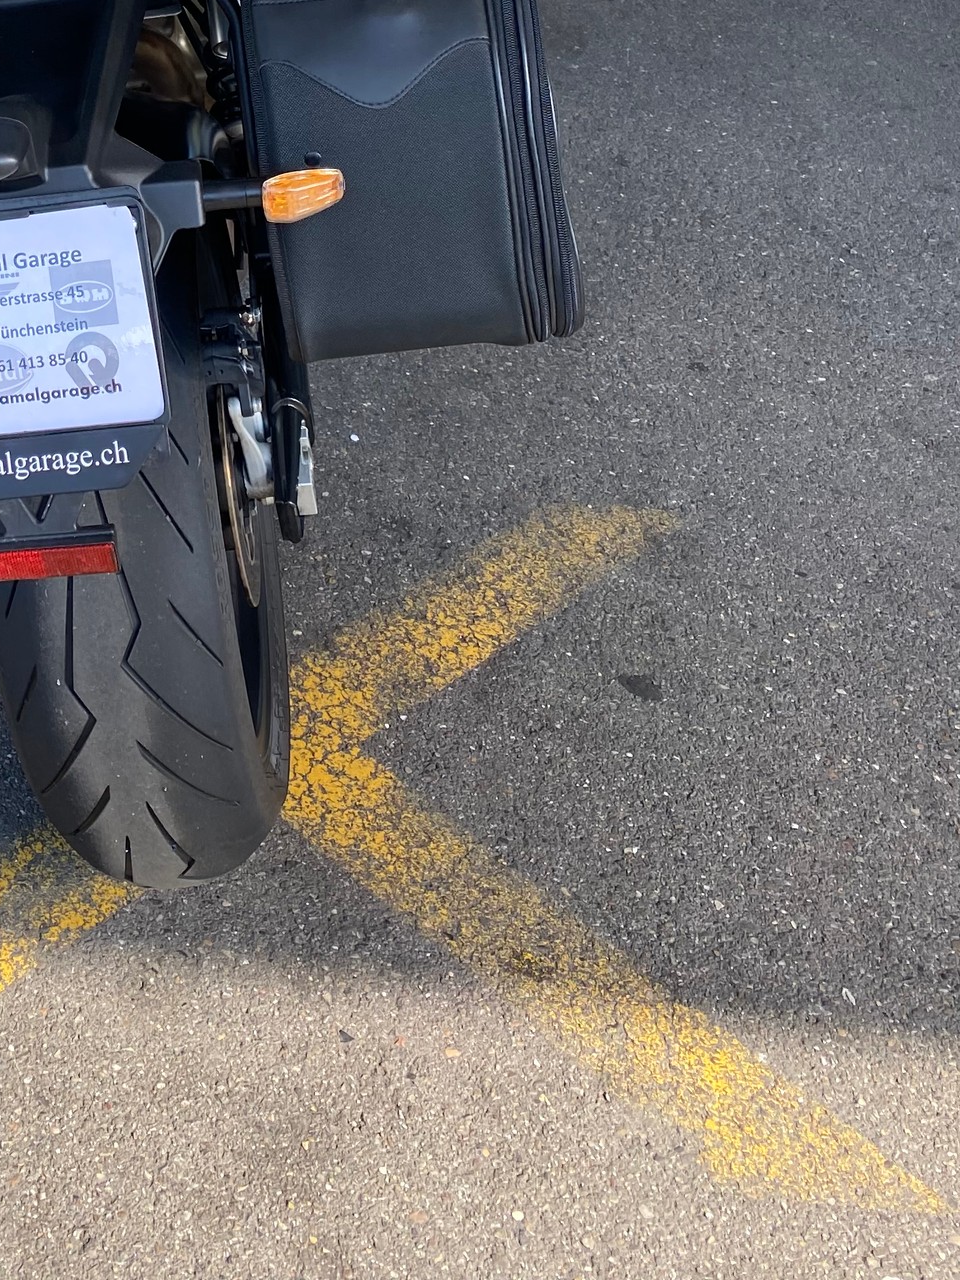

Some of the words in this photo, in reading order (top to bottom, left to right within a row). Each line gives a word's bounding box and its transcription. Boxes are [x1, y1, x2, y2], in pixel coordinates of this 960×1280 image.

[13, 249, 82, 269] Garage
[67, 285, 84, 299] 45
[18, 355, 45, 370] 413
[49, 353, 67, 367] 85
[70, 350, 88, 365] 40
